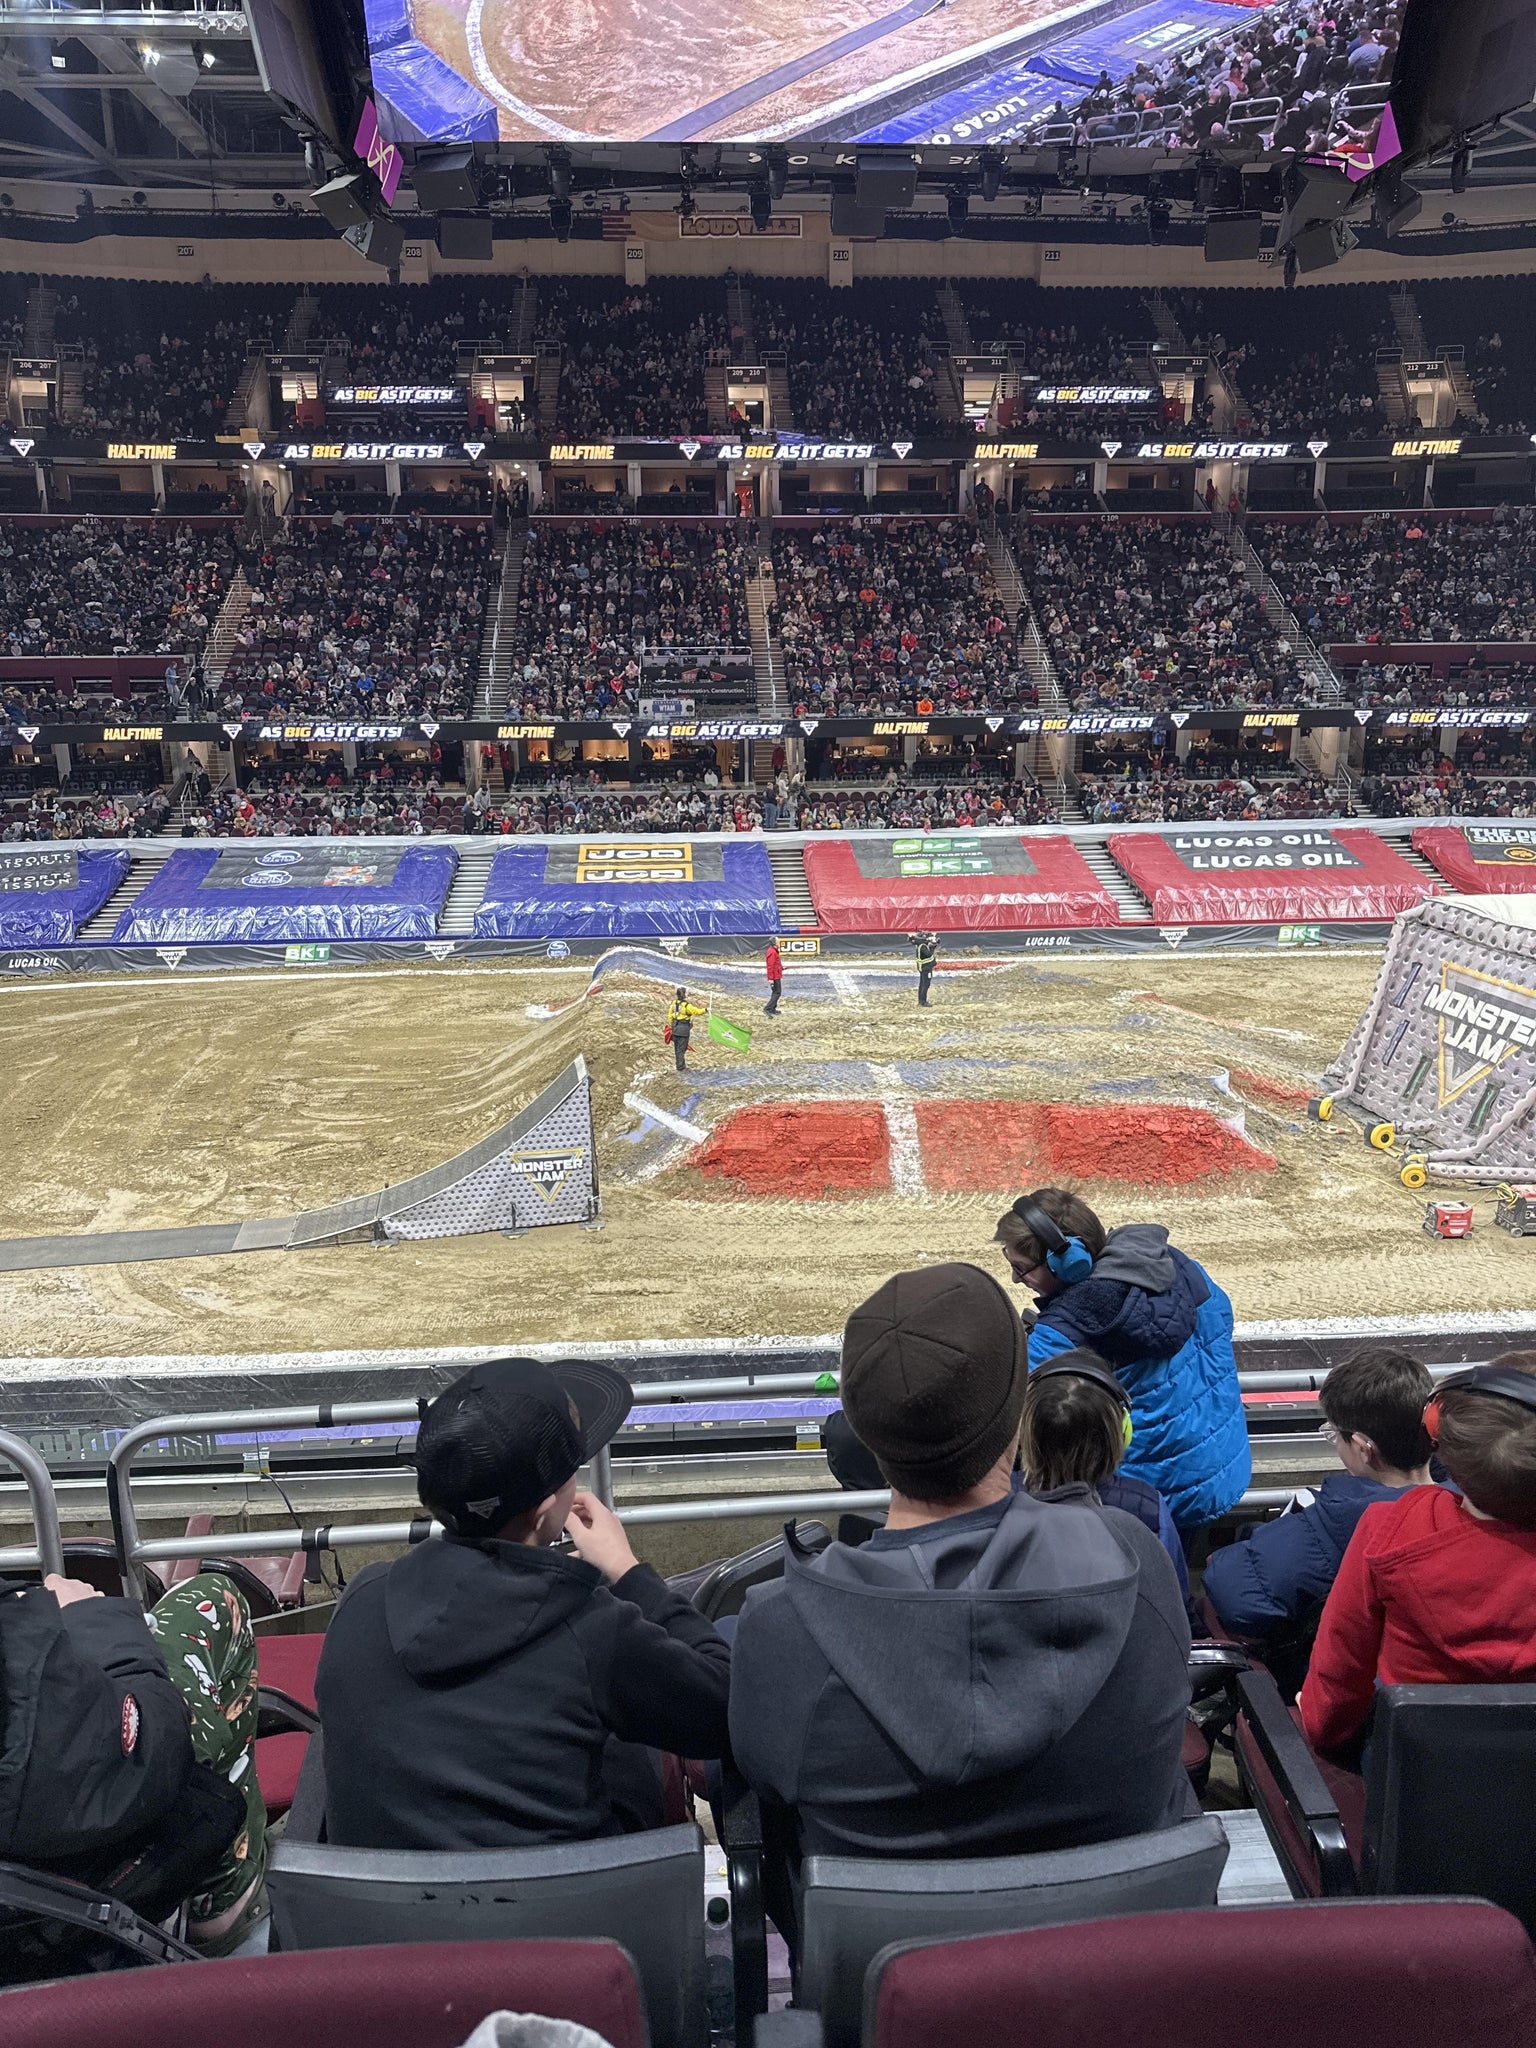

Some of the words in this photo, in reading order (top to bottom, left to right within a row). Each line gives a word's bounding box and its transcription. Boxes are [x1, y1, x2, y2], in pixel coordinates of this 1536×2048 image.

[952, 95, 1028, 137] LUCAS
[681, 217, 800, 236] LOUDVLE
[178, 247, 194, 255] 207
[406, 248, 421, 256] 208
[627, 250, 643, 258] 209
[833, 251, 848, 259] 210
[1045, 251, 1060, 260] 211
[1259, 253, 1273, 261] 212
[20, 361, 32, 369] 206
[334, 389, 354, 400] AS
[355, 389, 379, 400] BIG
[379, 389, 398, 400] AS
[398, 389, 415, 400] IT
[415, 389, 453, 400] GETS!
[1037, 389, 1056, 400] AS
[1056, 389, 1080, 400] BIG
[1079, 389, 1099, 400] AS
[1098, 389, 1114, 400] IT
[1113, 389, 1150, 400] GETS!
[107, 444, 177, 459] HALFTIME
[283, 445, 310, 459] AS
[311, 445, 342, 458] BIG
[344, 445, 370, 459] AS
[370, 445, 391, 458] IT
[392, 445, 446, 458] GETS!
[550, 445, 615, 460] HALFTIME
[717, 445, 743, 459] AS
[744, 445, 775, 459] BIG
[775, 445, 801, 458] AS
[801, 445, 822, 458] IT
[822, 445, 873, 458] GETS!
[974, 444, 1039, 459] HALFTIME
[1137, 444, 1163, 457] AS
[1163, 444, 1194, 457] BIG
[1194, 444, 1219, 457] AS
[1218, 444, 1240, 457] IT
[1240, 444, 1289, 457] GETS!
[1391, 440, 1462, 456] HALFTIME
[864, 517, 869, 525] C
[869, 517, 882, 525] 108
[1101, 514, 1106, 522] C
[1018, 719, 1041, 731] AS
[1041, 719, 1068, 730] BIG
[1068, 718, 1090, 730] AS
[1090, 717, 1110, 729] IT
[1109, 717, 1153, 729] GETS!
[1243, 713, 1299, 727] HALFTIME
[1386, 712, 1409, 724] AS
[1409, 712, 1437, 723] BIG
[1437, 712, 1460, 723] AS
[1461, 712, 1480, 723] IT
[1480, 712, 1528, 723] GETS!
[103, 727, 163, 740] HALFTIME
[259, 726, 282, 738] AS
[284, 726, 311, 738] BIG
[313, 726, 336, 738] AS
[337, 726, 356, 738] IT
[356, 726, 402, 738] GETS!
[497, 726, 556, 739] HALFTIME
[647, 725, 670, 737] AS
[670, 725, 697, 736] BIG
[697, 725, 720, 736] AS
[720, 725, 739, 736] IT
[739, 725, 783, 736] GETS!
[873, 722, 930, 735] HALFTIME
[1470, 827, 1511, 837] THE
[1175, 835, 1273, 848] LUCAS
[903, 860, 989, 871] BKT
[1192, 853, 1293, 868] LUCAS
[586, 870, 684, 881] JCB
[1281, 927, 1320, 939] BKT
[780, 941, 817, 952] JCB
[1025, 936, 1056, 946] LUCAS
[287, 947, 329, 960] BKT
[8, 958, 41, 969] LUCAS
[43, 957, 59, 967] OIL
[1443, 1022, 1508, 1063] JAM
[510, 1159, 584, 1173] MONSTER
[532, 1170, 565, 1182] JAM
